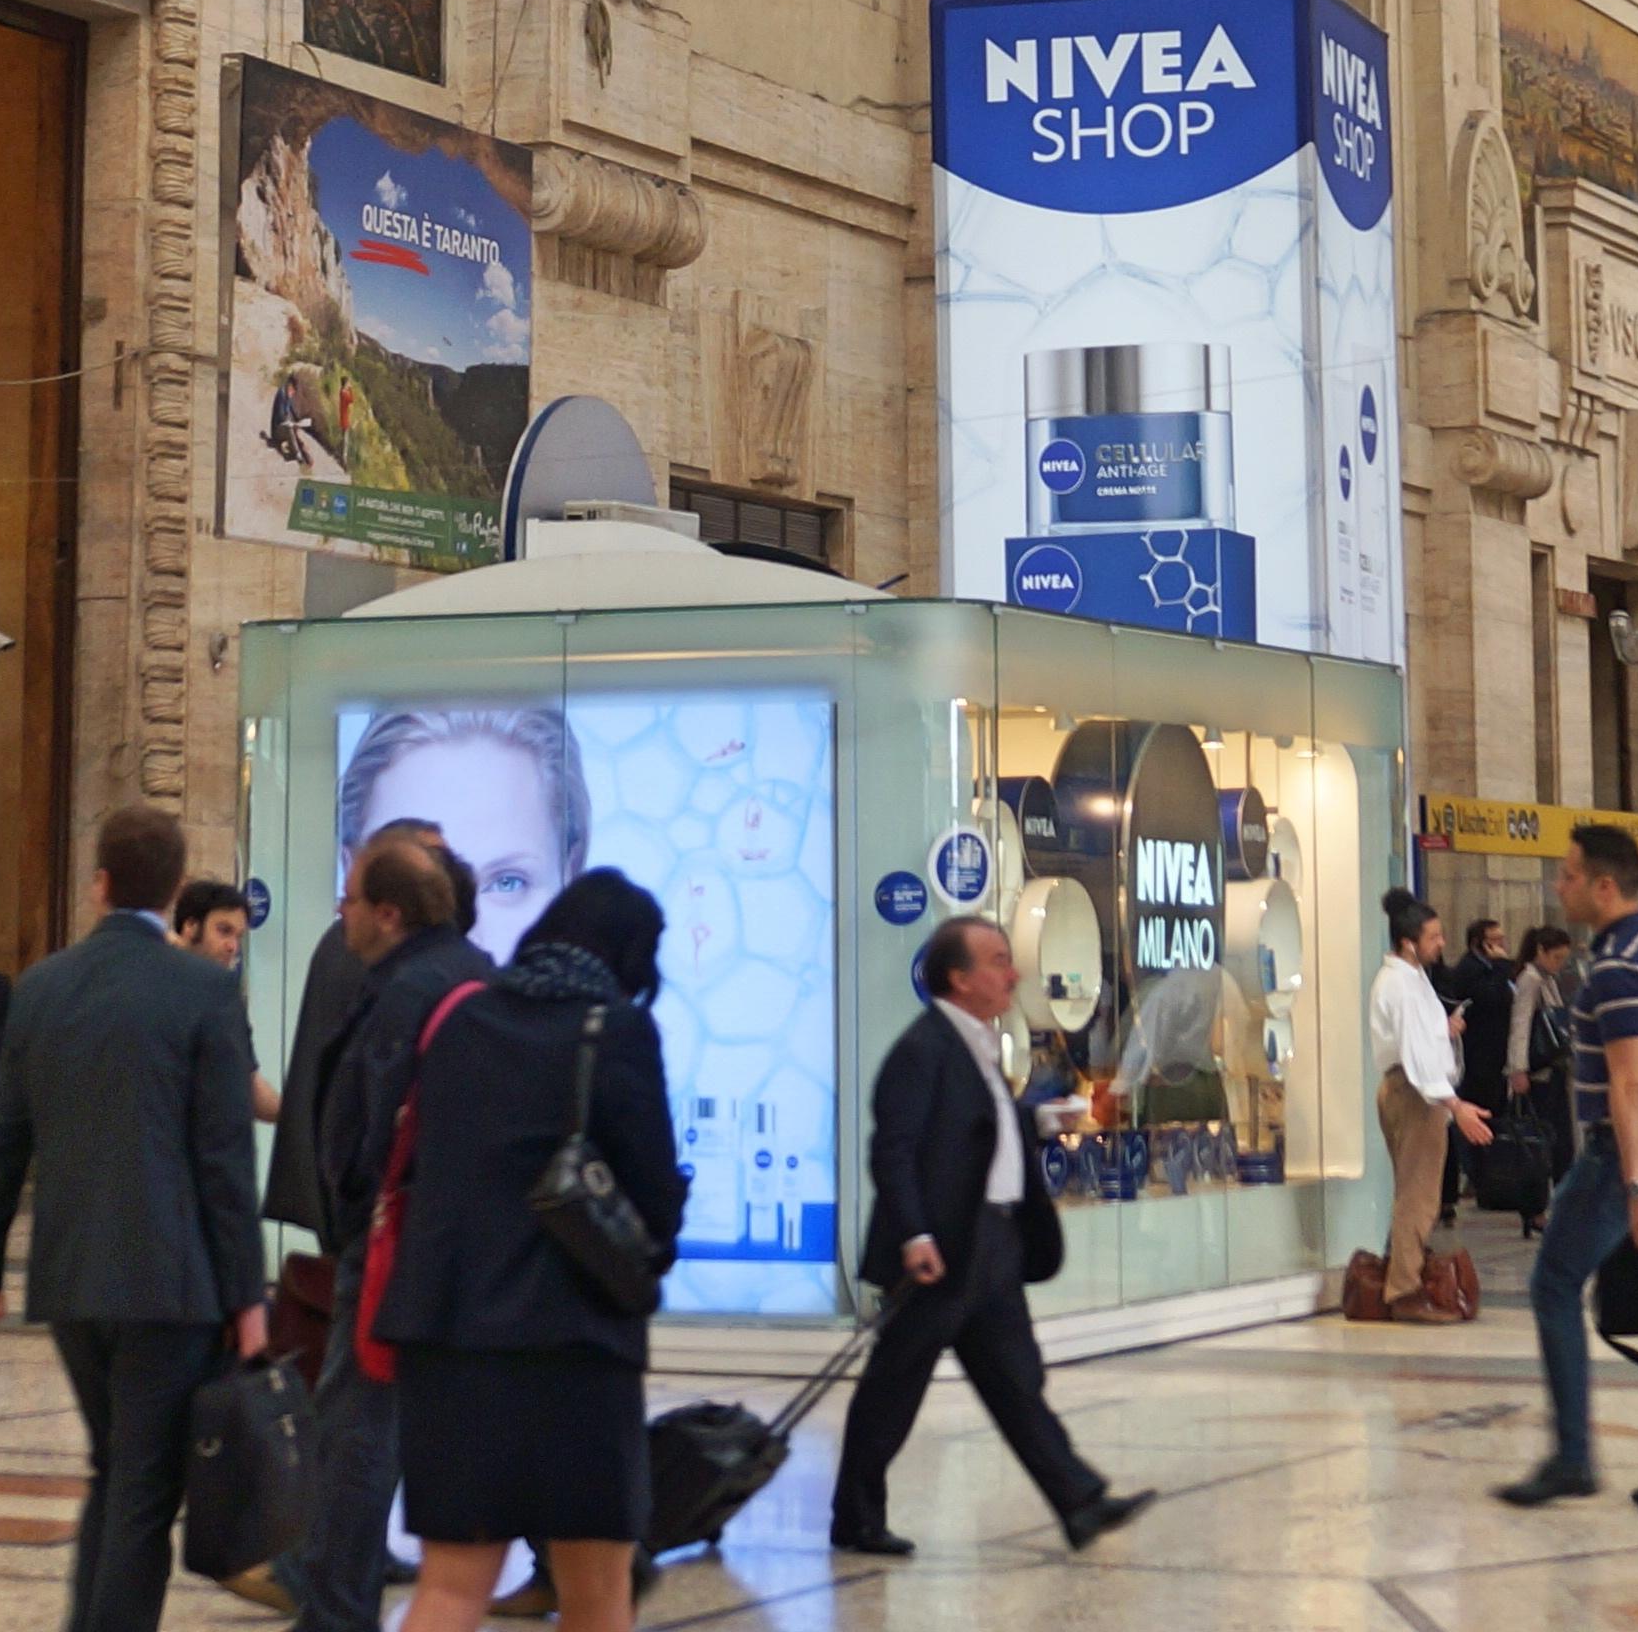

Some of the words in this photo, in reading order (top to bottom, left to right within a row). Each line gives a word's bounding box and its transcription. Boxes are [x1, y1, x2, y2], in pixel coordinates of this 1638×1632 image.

[985, 23, 1257, 104] NIVEA
[1320, 29, 1383, 132] NIVEA
[1032, 100, 1216, 164] SHOP
[1333, 111, 1376, 182] SHOP
[362, 204, 419, 245] QUESTA
[421, 212, 432, 248] È
[1042, 459, 1080, 473] NIVEA
[1096, 464, 1169, 481] ANTI-AGE
[1022, 574, 1075, 590] NIVEA
[1136, 835, 1214, 907] NIVEA
[1136, 916, 1215, 971] MILANO
